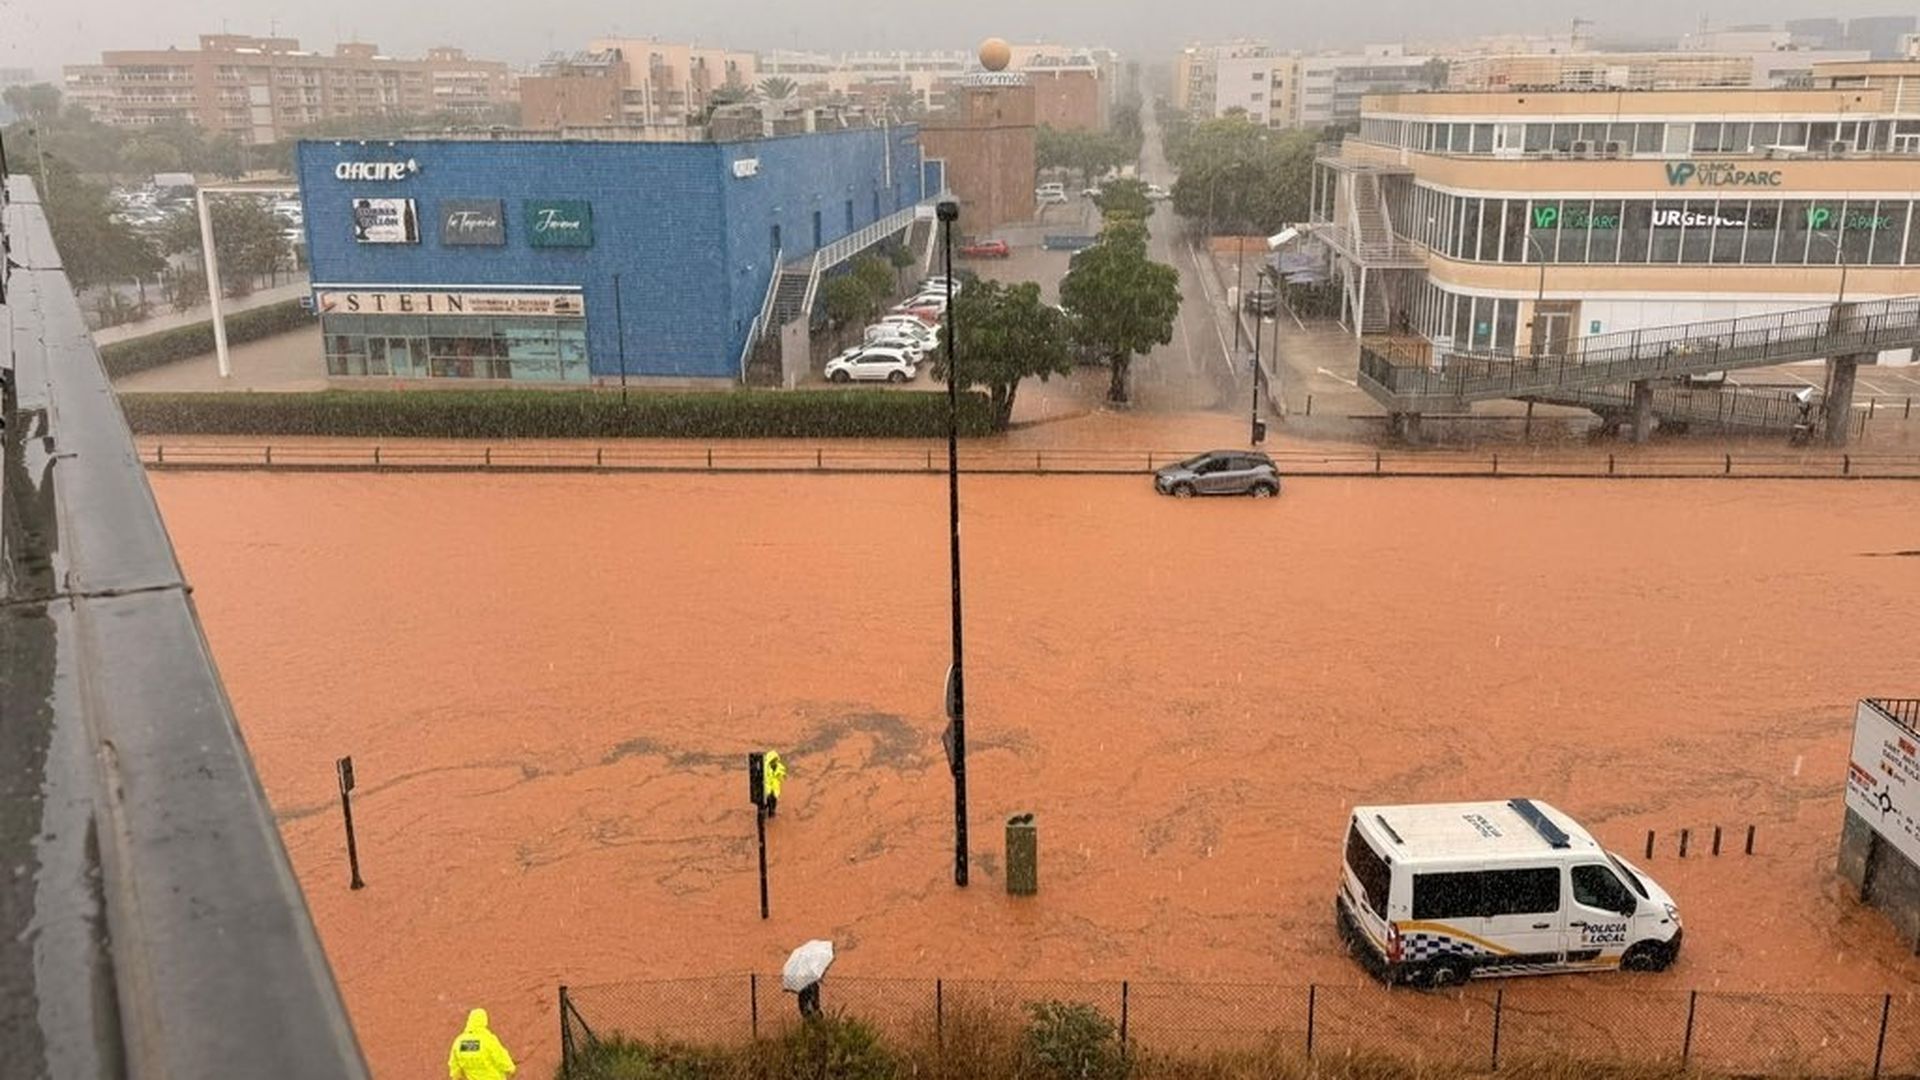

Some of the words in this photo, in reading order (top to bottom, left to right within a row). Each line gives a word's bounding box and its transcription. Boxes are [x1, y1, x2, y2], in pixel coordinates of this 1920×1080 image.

[1698, 171, 1783, 186] VILAPARC
[1534, 207, 1557, 228] VP
[346, 294, 464, 312] STEIN
[1590, 933, 1626, 943] LOCAL
